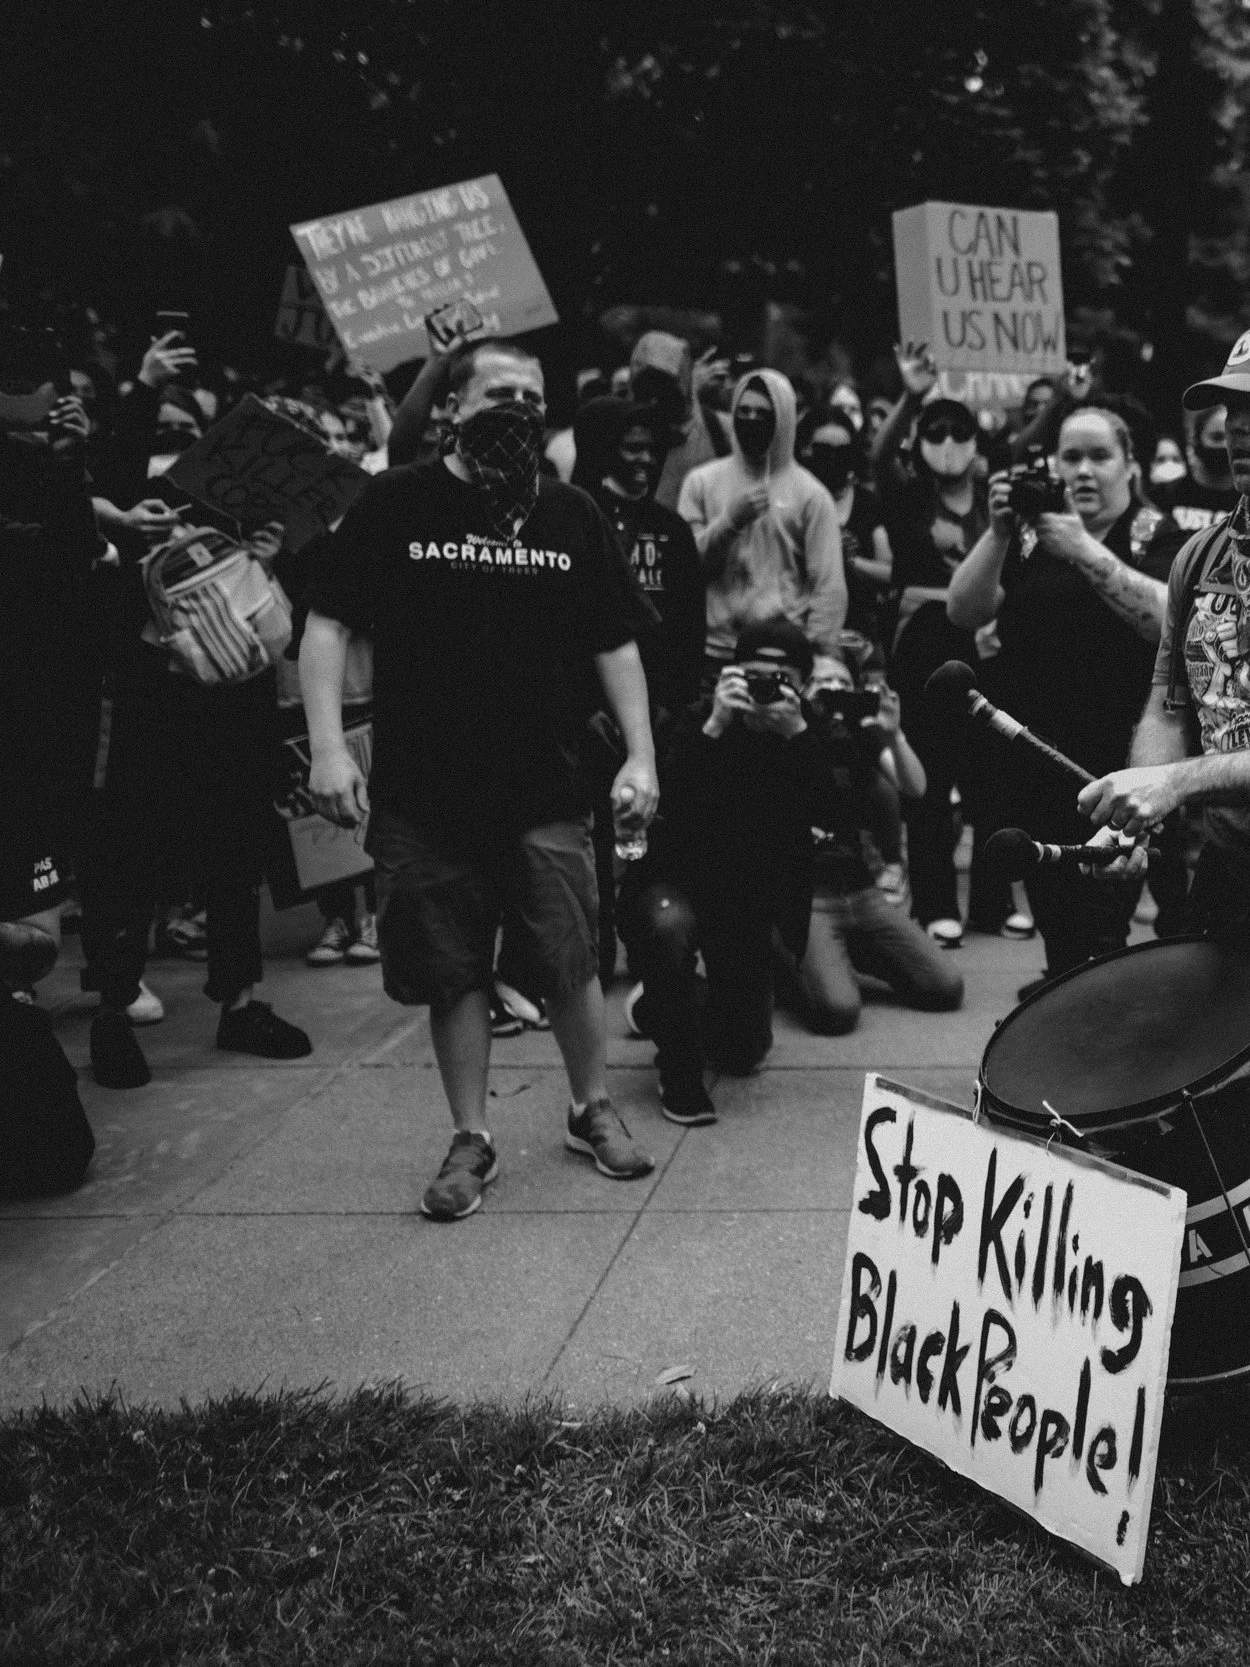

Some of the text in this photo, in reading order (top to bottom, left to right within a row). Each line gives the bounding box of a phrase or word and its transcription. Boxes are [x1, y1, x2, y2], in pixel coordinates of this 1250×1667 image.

[949, 210, 1021, 257] CAN
[936, 257, 1048, 304] U HEAR
[943, 310, 1060, 354] US NOW
[408, 541, 572, 572] SACRAMENTO
[450, 560, 477, 571] CITY
[858, 1106, 1154, 1375] Stop Killing
[844, 1251, 1146, 1546] Black People!
